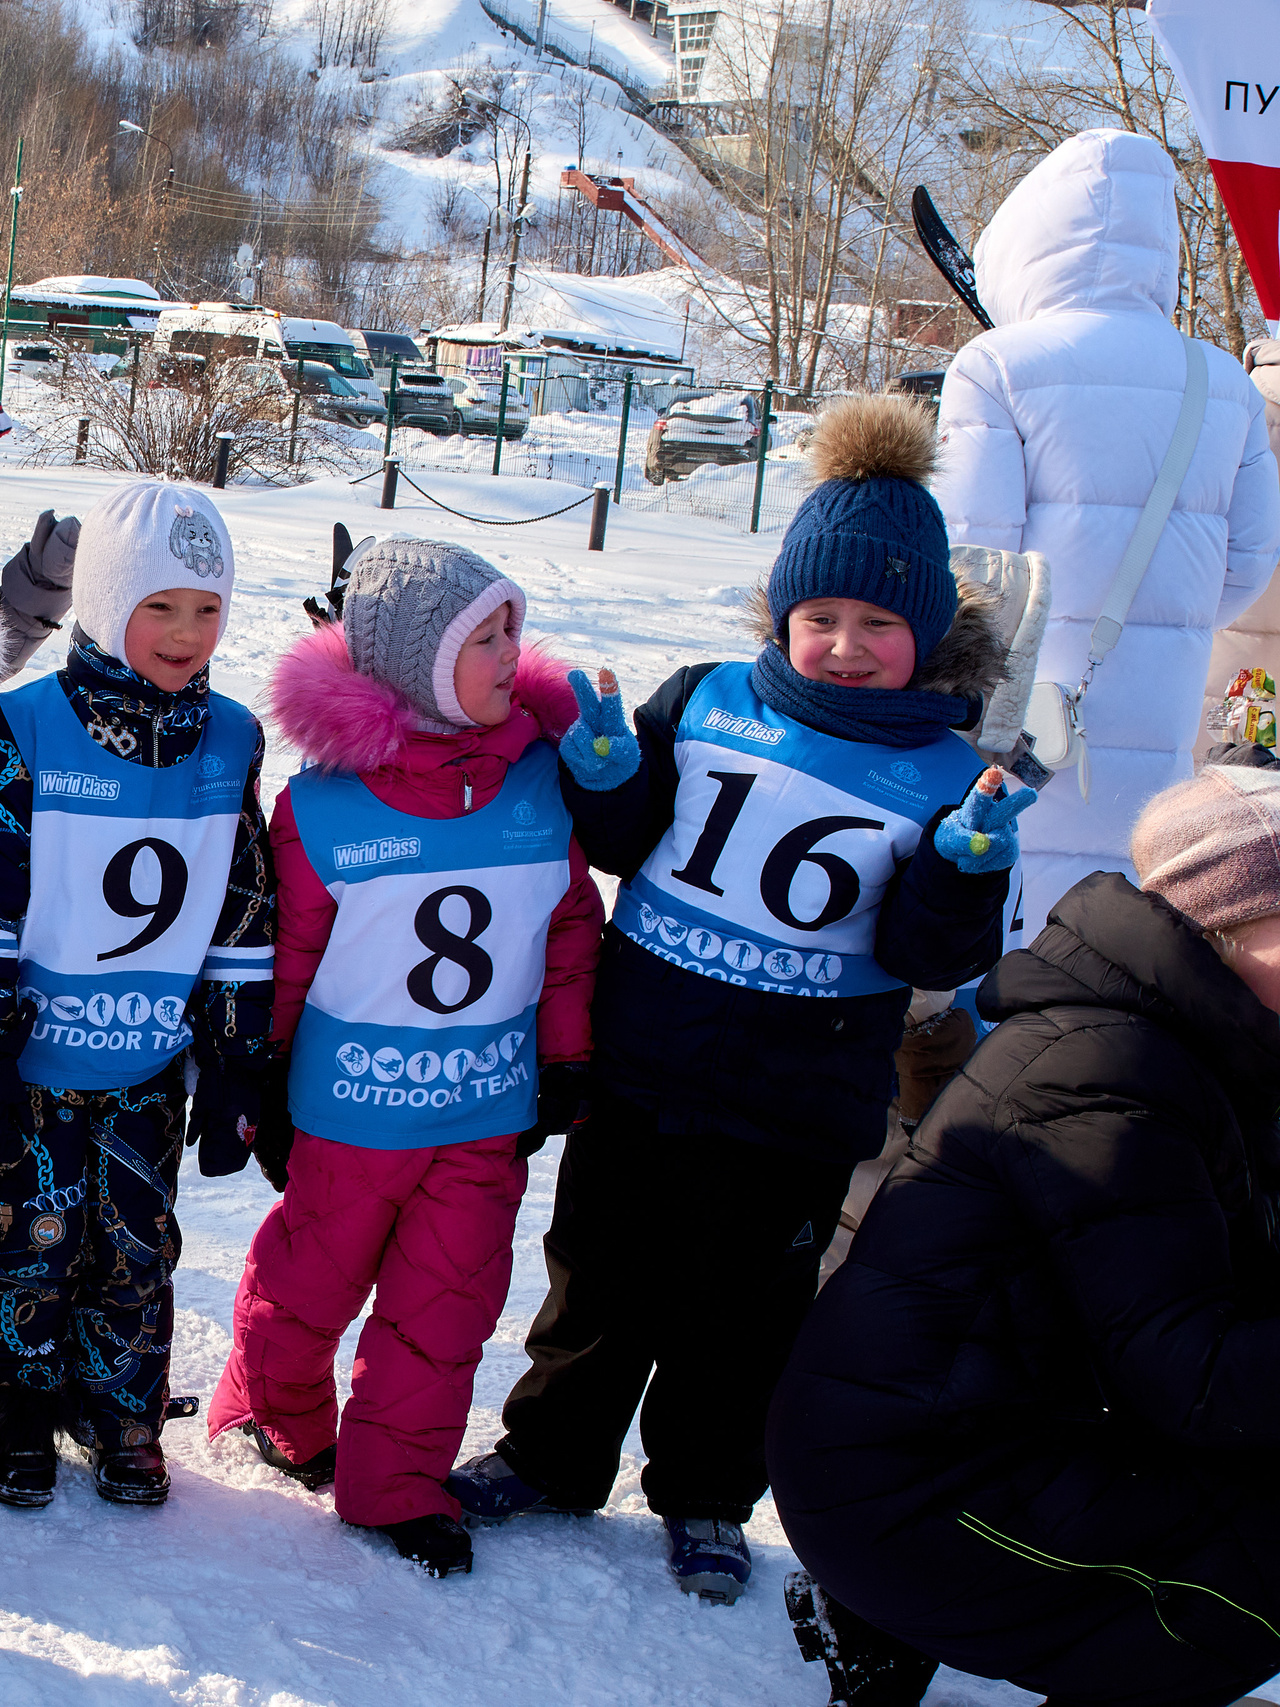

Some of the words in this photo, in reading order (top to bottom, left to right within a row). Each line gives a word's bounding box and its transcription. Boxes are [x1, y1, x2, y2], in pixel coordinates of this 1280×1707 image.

[706, 710, 746, 733] World
[744, 720, 781, 743] Class
[42, 773, 81, 795] World
[81, 776, 118, 798] Class
[192, 779, 240, 795] ушкинский
[867, 769, 929, 801] Пушкинский
[336, 842, 377, 867] World
[378, 839, 418, 861] Class
[671, 770, 885, 931] 16
[97, 837, 188, 961] 9
[406, 885, 493, 1015] 8
[30, 1021, 143, 1051] UTDOOR
[332, 1080, 462, 1109] OUTDOOR
[470, 1061, 529, 1099] TEAM
